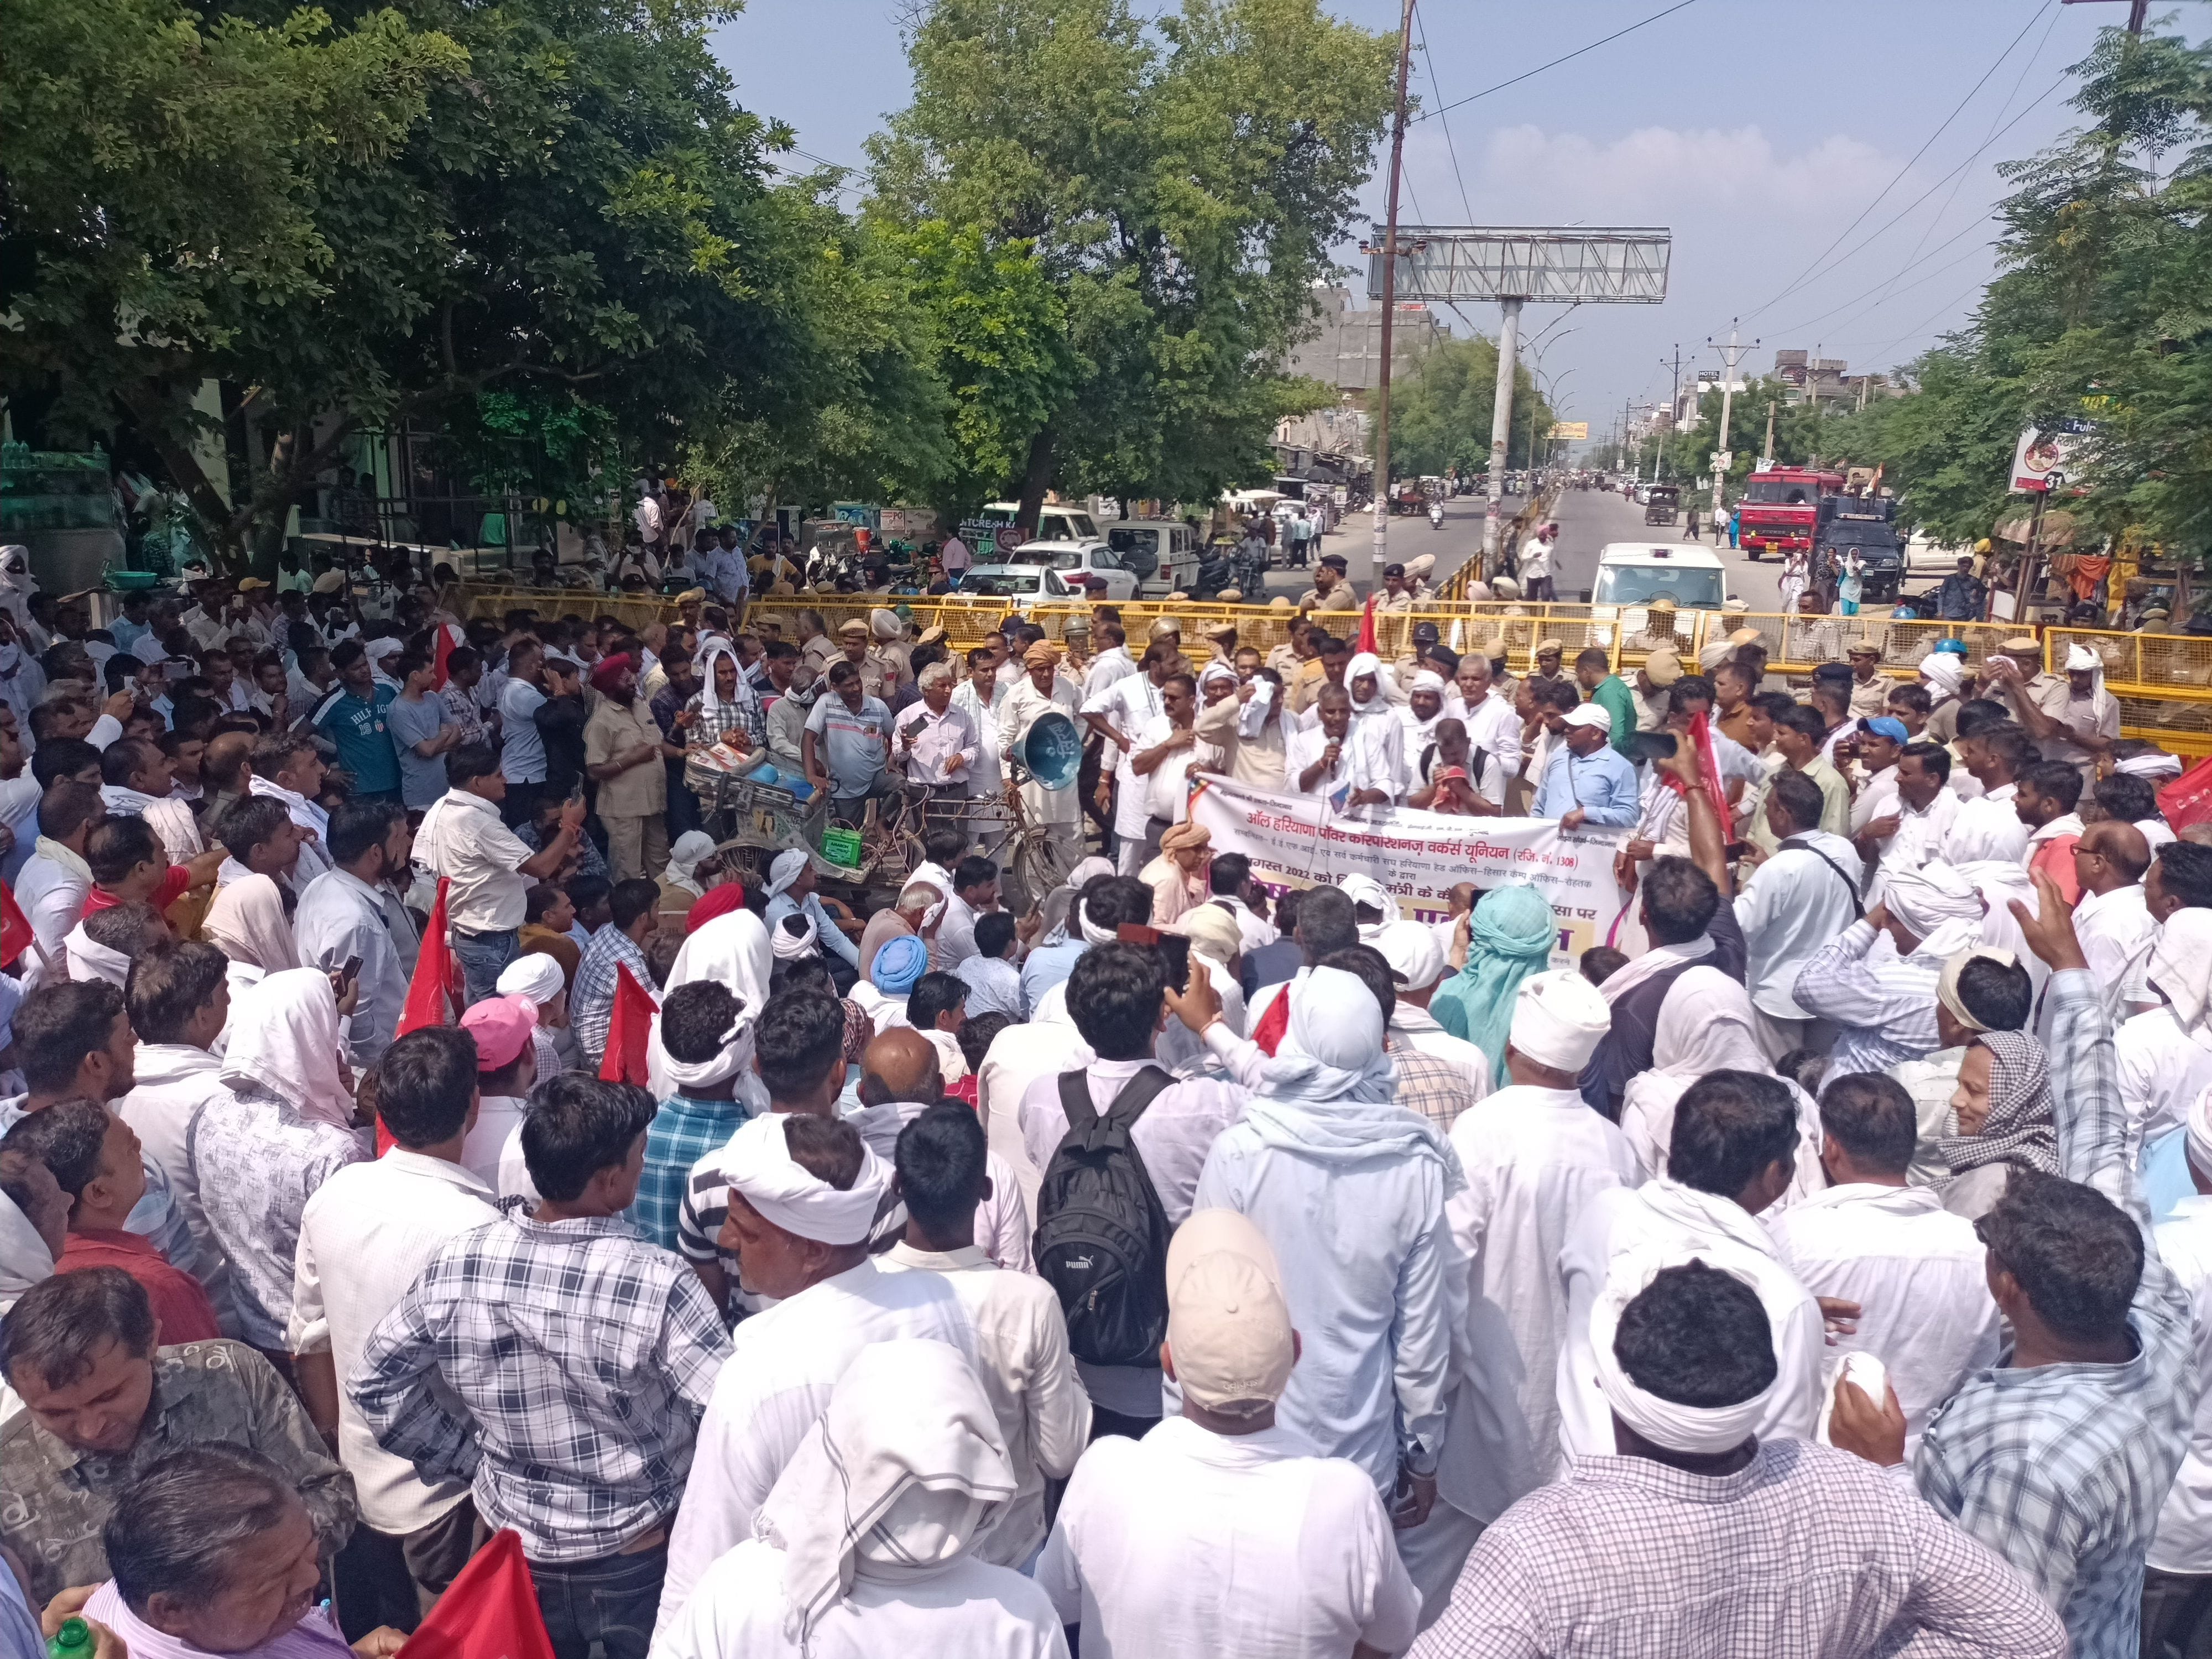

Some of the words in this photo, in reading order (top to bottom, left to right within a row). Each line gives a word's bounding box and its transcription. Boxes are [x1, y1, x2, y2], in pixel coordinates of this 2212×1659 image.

[2045, 474, 2062, 489] 31
[1246, 810, 1270, 828] ऑल
[1273, 815, 1315, 837] हरियाणा
[1319, 825, 1346, 843] पॉवर
[1428, 838, 1463, 855] वर्कर्स
[1465, 840, 1510, 863] यूनियन
[1334, 849, 1347, 859] सर्व
[1349, 851, 1380, 864] कर्मचारी
[1399, 858, 1431, 872] हरियाणा
[1387, 868, 1397, 878] के
[1399, 872, 1416, 880] द्वारा
[1286, 865, 1310, 880] 2022
[1313, 872, 1333, 884] को
[1417, 885, 1433, 899] के
[1575, 907, 1598, 921] पर
